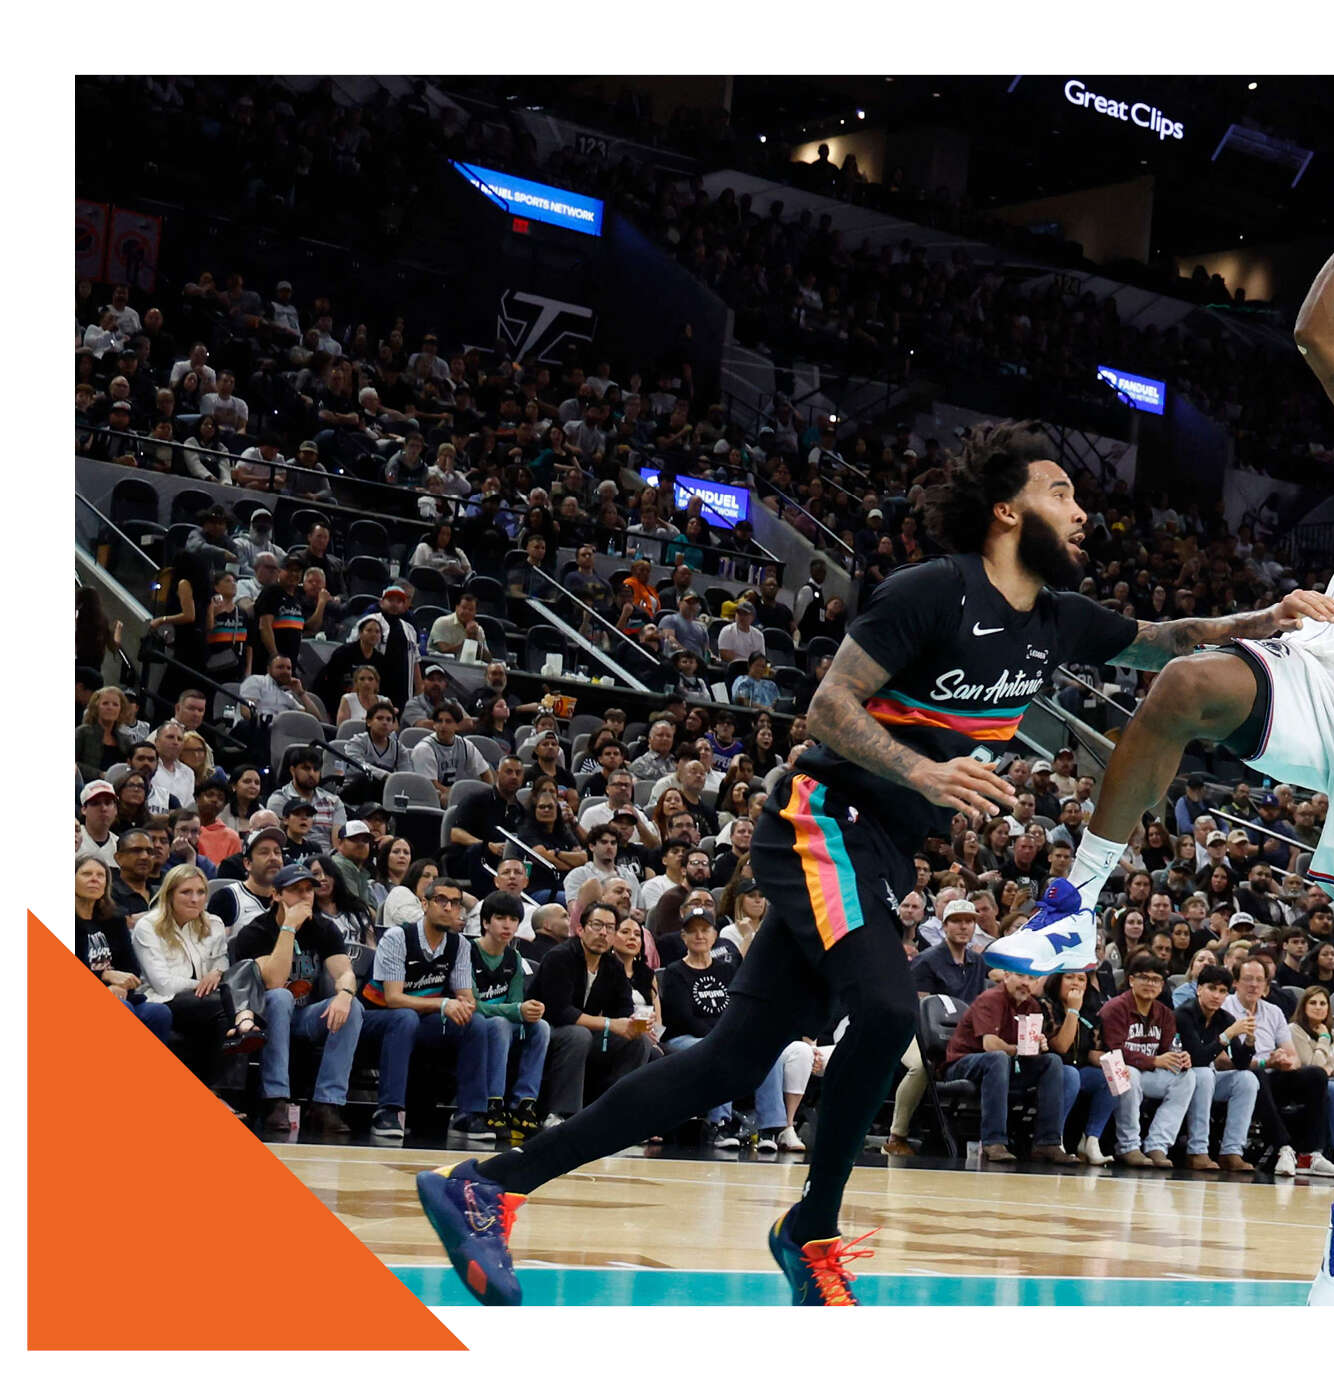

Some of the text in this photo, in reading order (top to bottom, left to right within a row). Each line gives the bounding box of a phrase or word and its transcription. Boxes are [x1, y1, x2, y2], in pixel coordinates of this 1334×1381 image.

[1064, 80, 1184, 140] Great Clips
[514, 192, 550, 210] SPORTS
[551, 202, 595, 222] NETWORK
[930, 668, 984, 701] San
